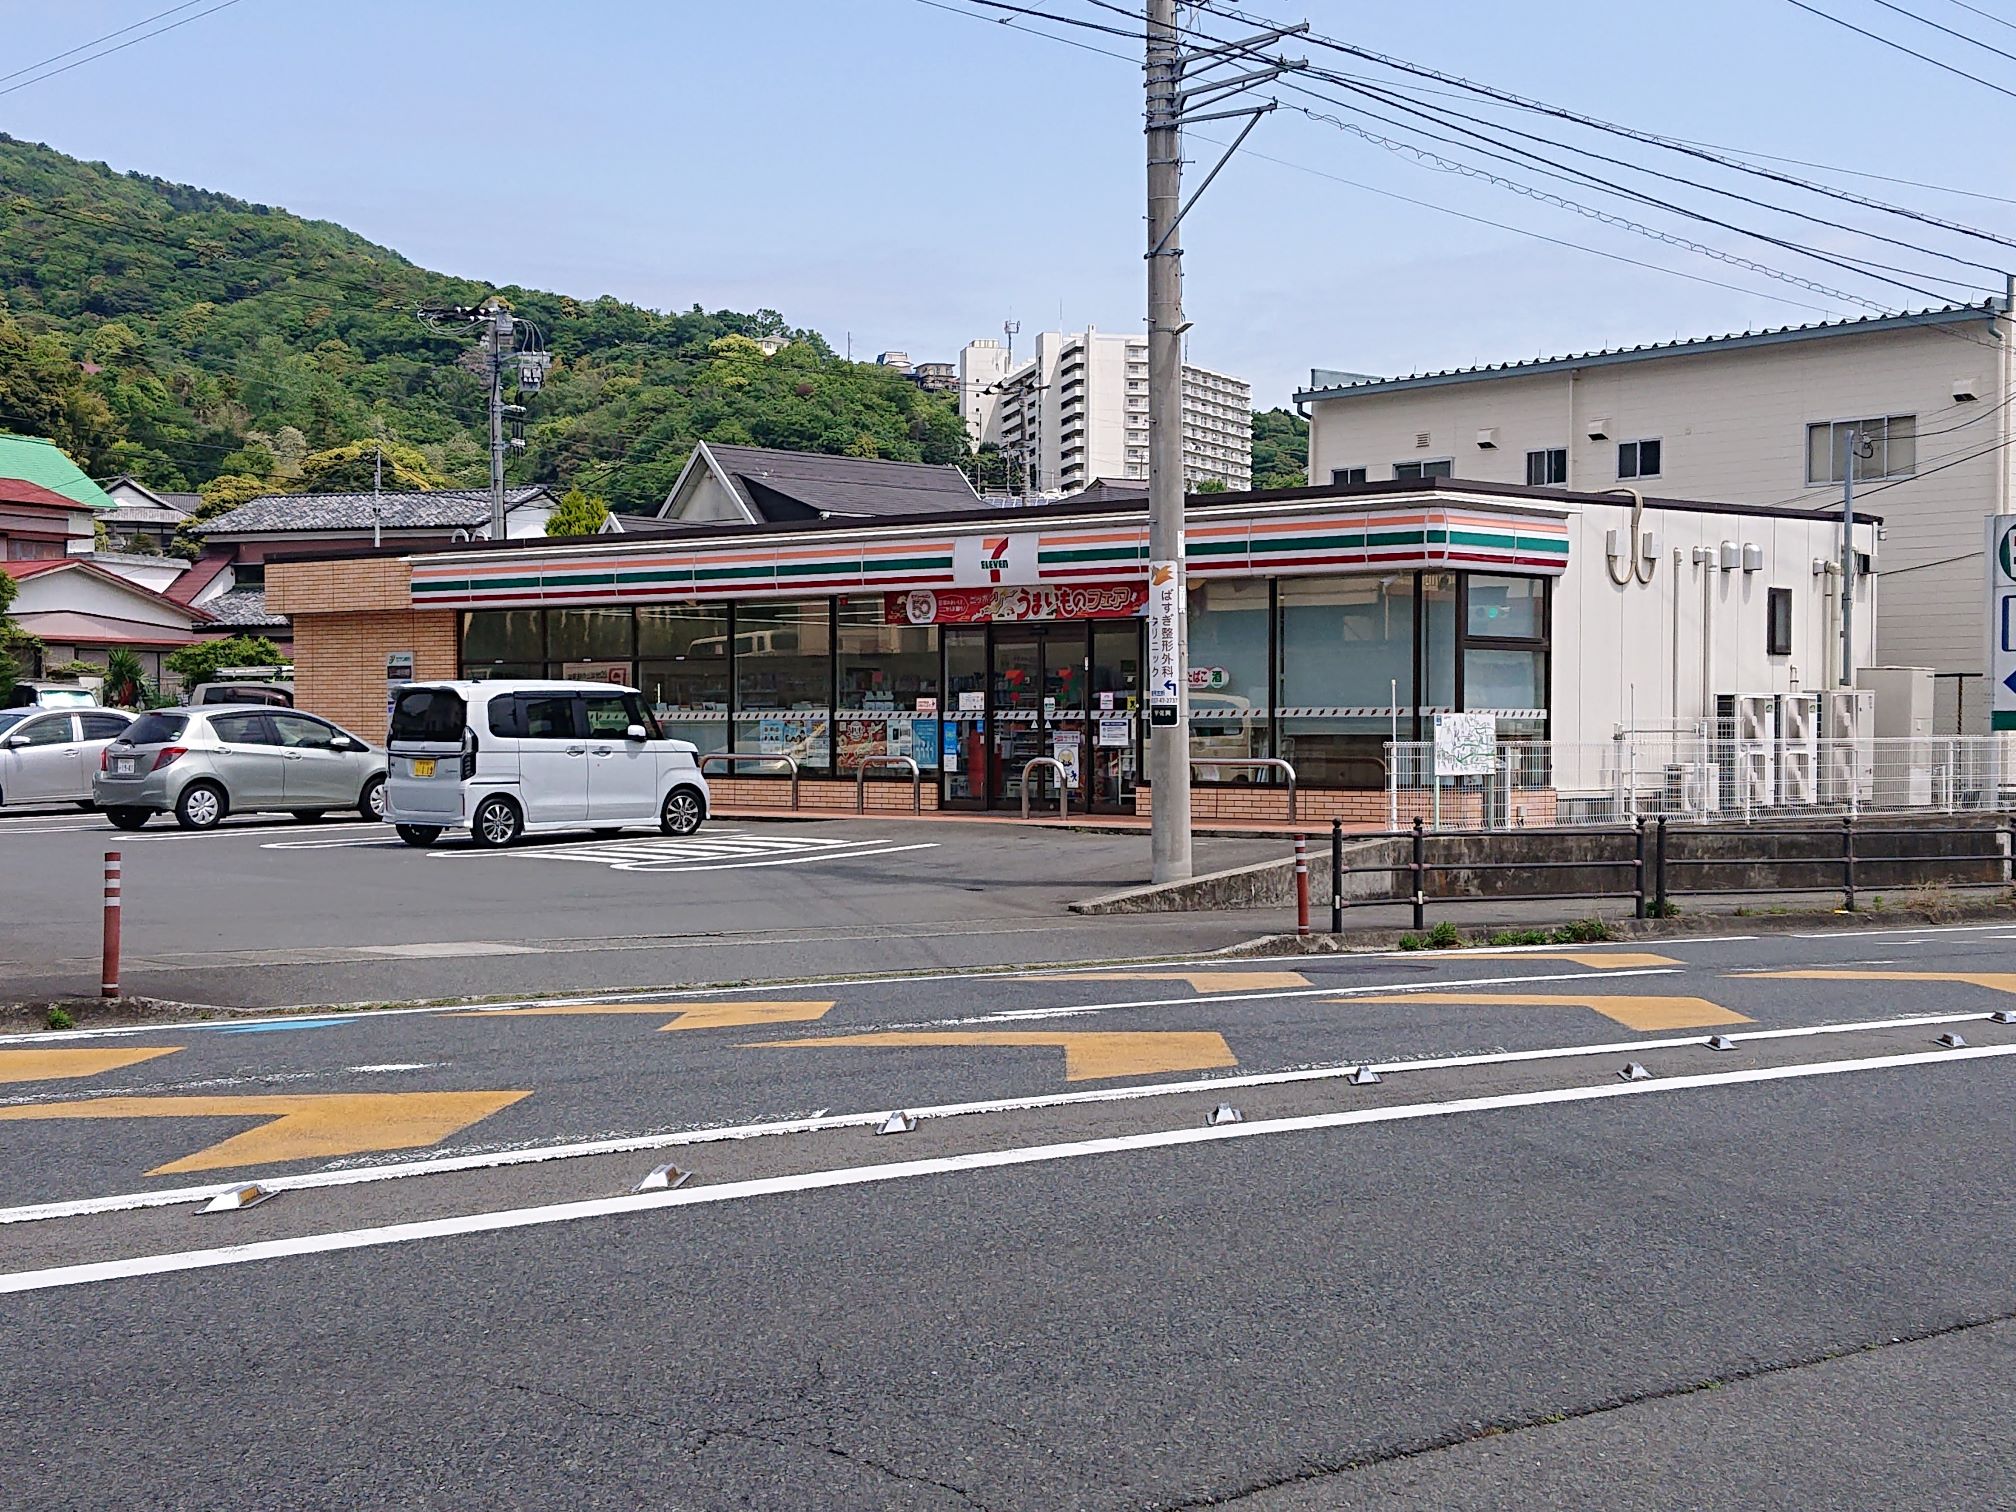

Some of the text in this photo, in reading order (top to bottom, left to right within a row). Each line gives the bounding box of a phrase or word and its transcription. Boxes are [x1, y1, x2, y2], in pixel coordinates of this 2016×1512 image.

[1017, 587, 1131, 619] うまいものフェア
[1151, 616, 1160, 678] クリニック
[1212, 670, 1222, 683] 酒
